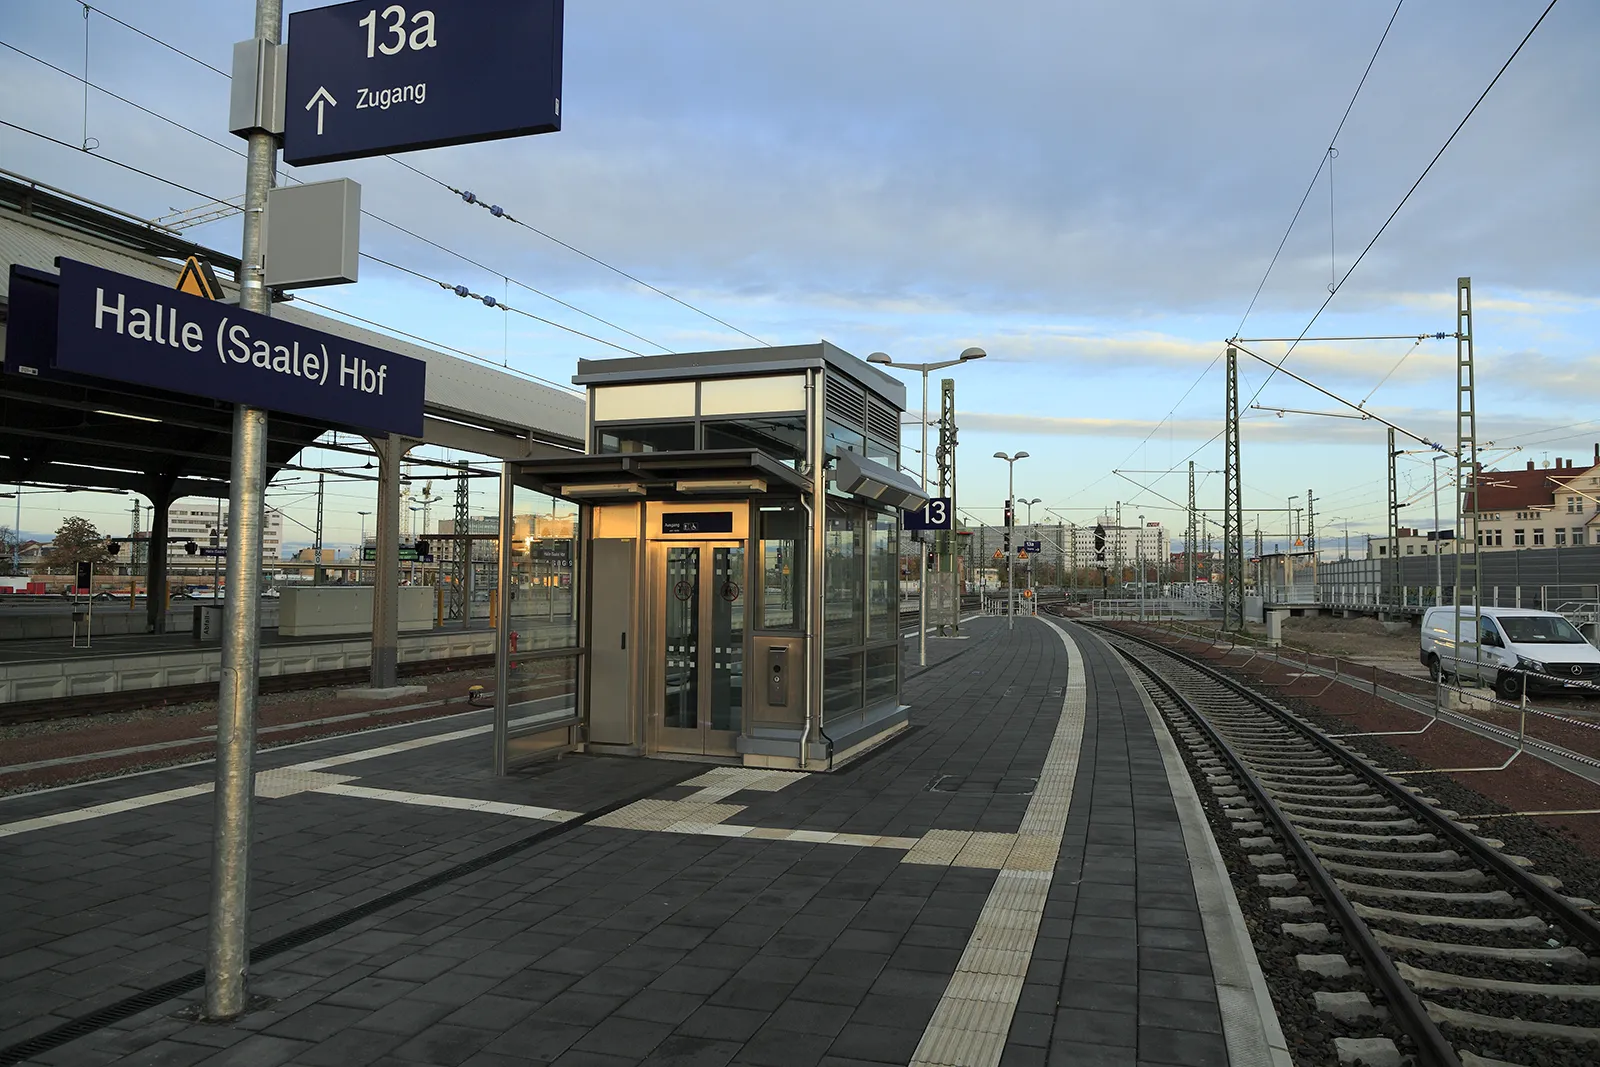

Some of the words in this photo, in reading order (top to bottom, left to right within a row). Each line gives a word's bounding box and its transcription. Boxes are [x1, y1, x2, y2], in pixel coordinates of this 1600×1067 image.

[359, 5, 437, 58] 13a
[356, 83, 426, 110] Zugang
[95, 287, 203, 352] Halle
[216, 317, 329, 386] (Saale)
[339, 353, 387, 395] Hbf
[923, 500, 946, 524] 13
